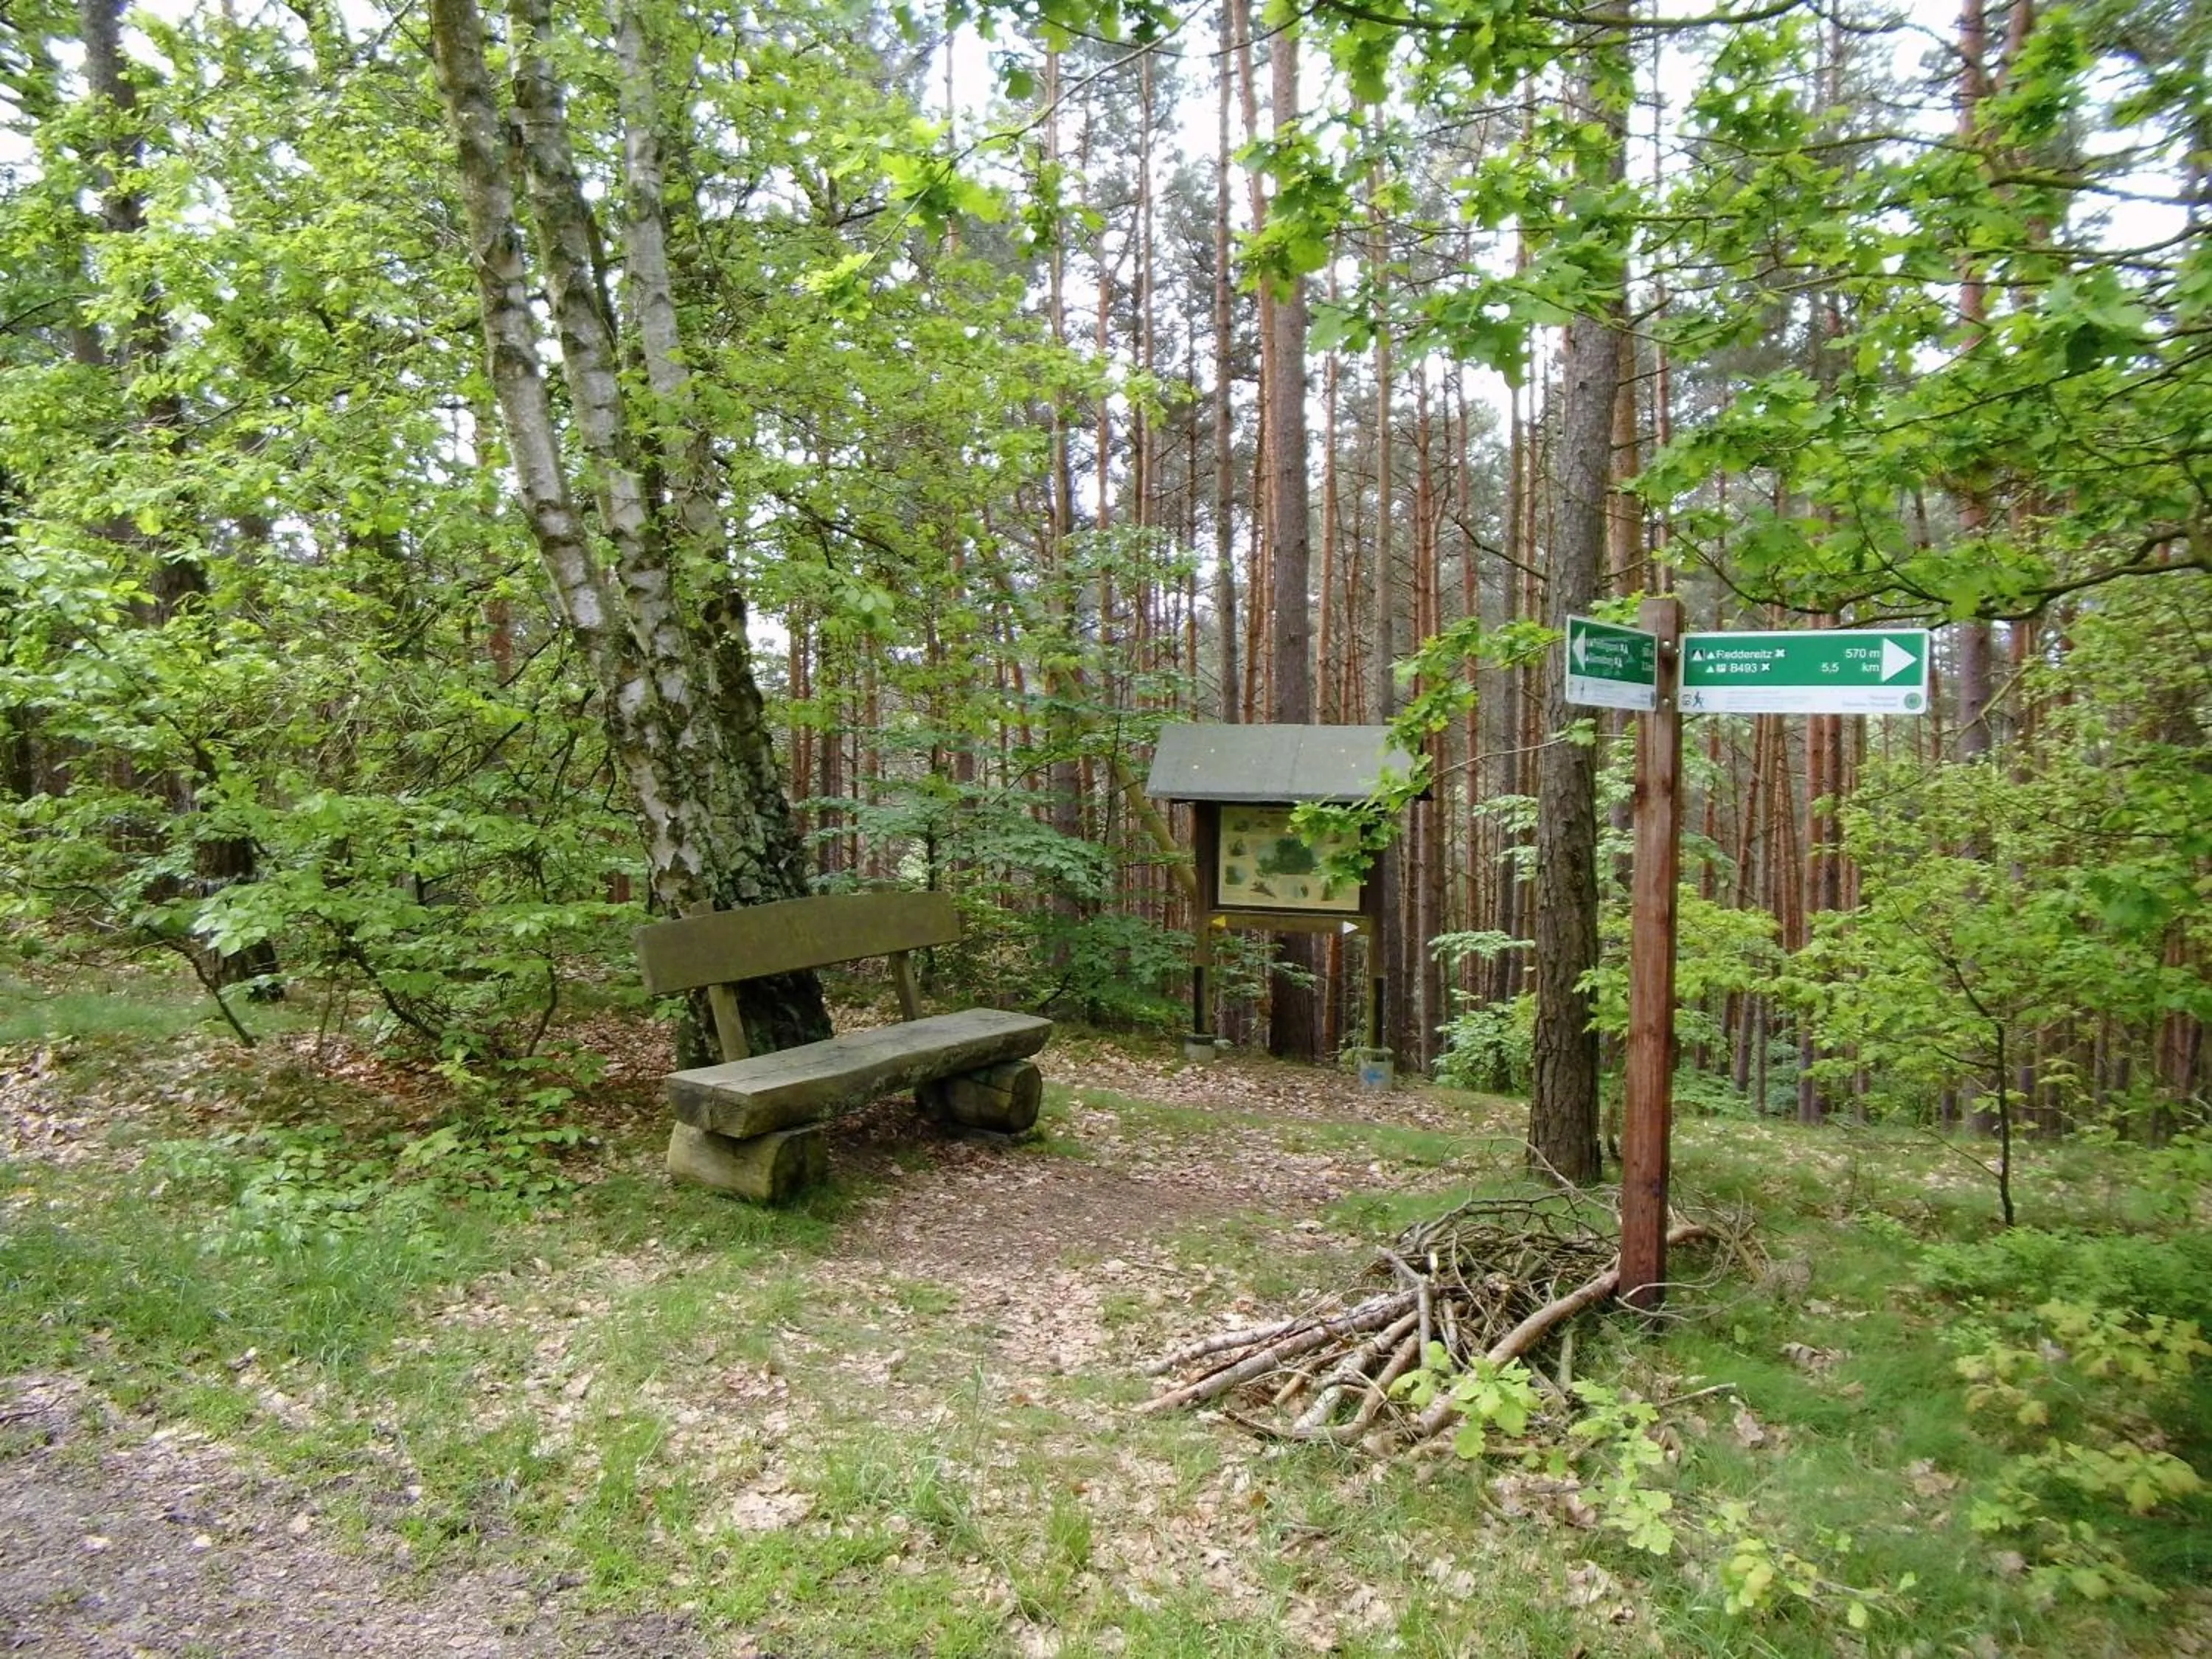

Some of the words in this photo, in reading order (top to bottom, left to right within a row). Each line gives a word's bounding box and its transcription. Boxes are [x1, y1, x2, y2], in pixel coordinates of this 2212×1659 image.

[1846, 648, 1866, 658] 570
[1869, 650, 1880, 658] m
[1730, 663, 1757, 673] B493
[1821, 661, 1840, 673] 5,5
[1862, 662, 1879, 672] km
